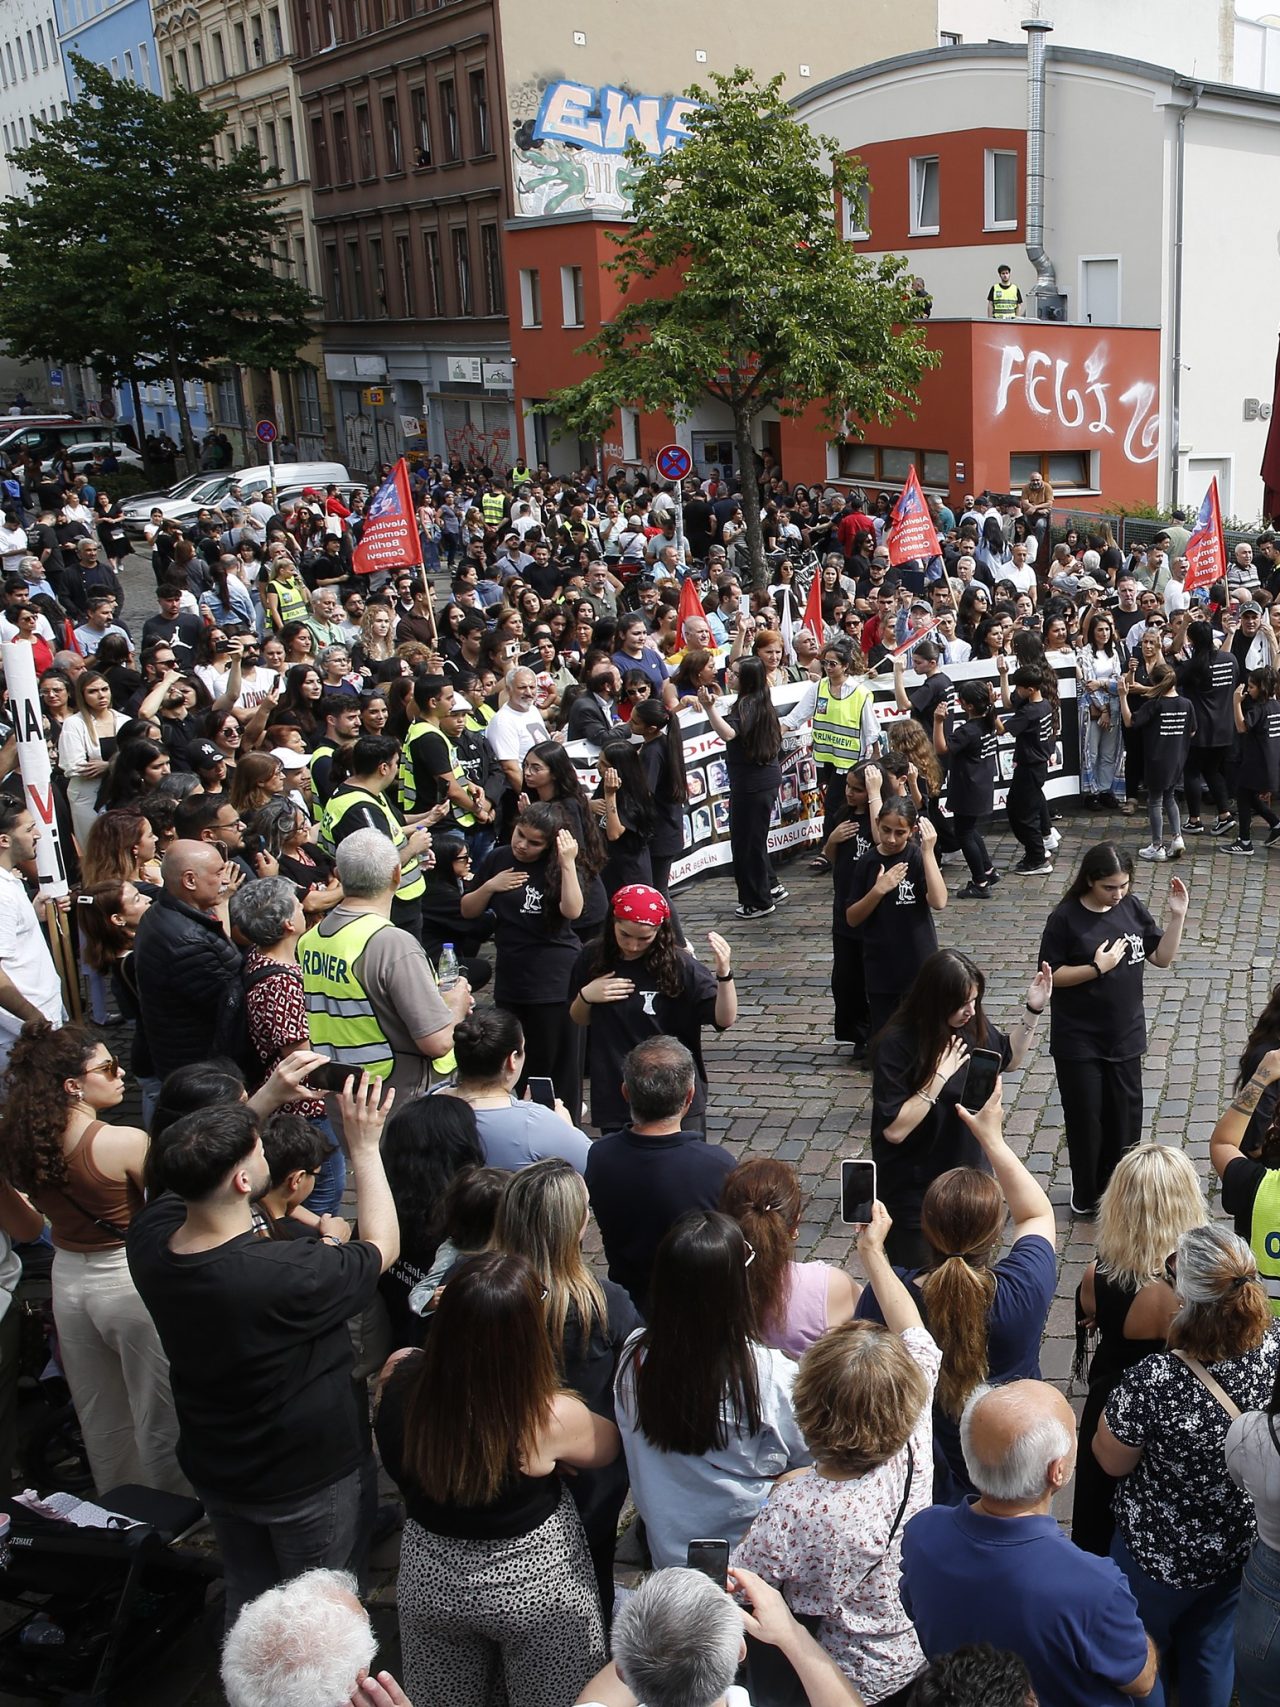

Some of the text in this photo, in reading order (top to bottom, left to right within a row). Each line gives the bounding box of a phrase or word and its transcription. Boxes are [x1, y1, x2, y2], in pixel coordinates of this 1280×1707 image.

[802, 824, 824, 838] CAN
[669, 862, 692, 882] NLAR
[303, 950, 350, 984] RDNER
[403, 1261, 426, 1280] canla
